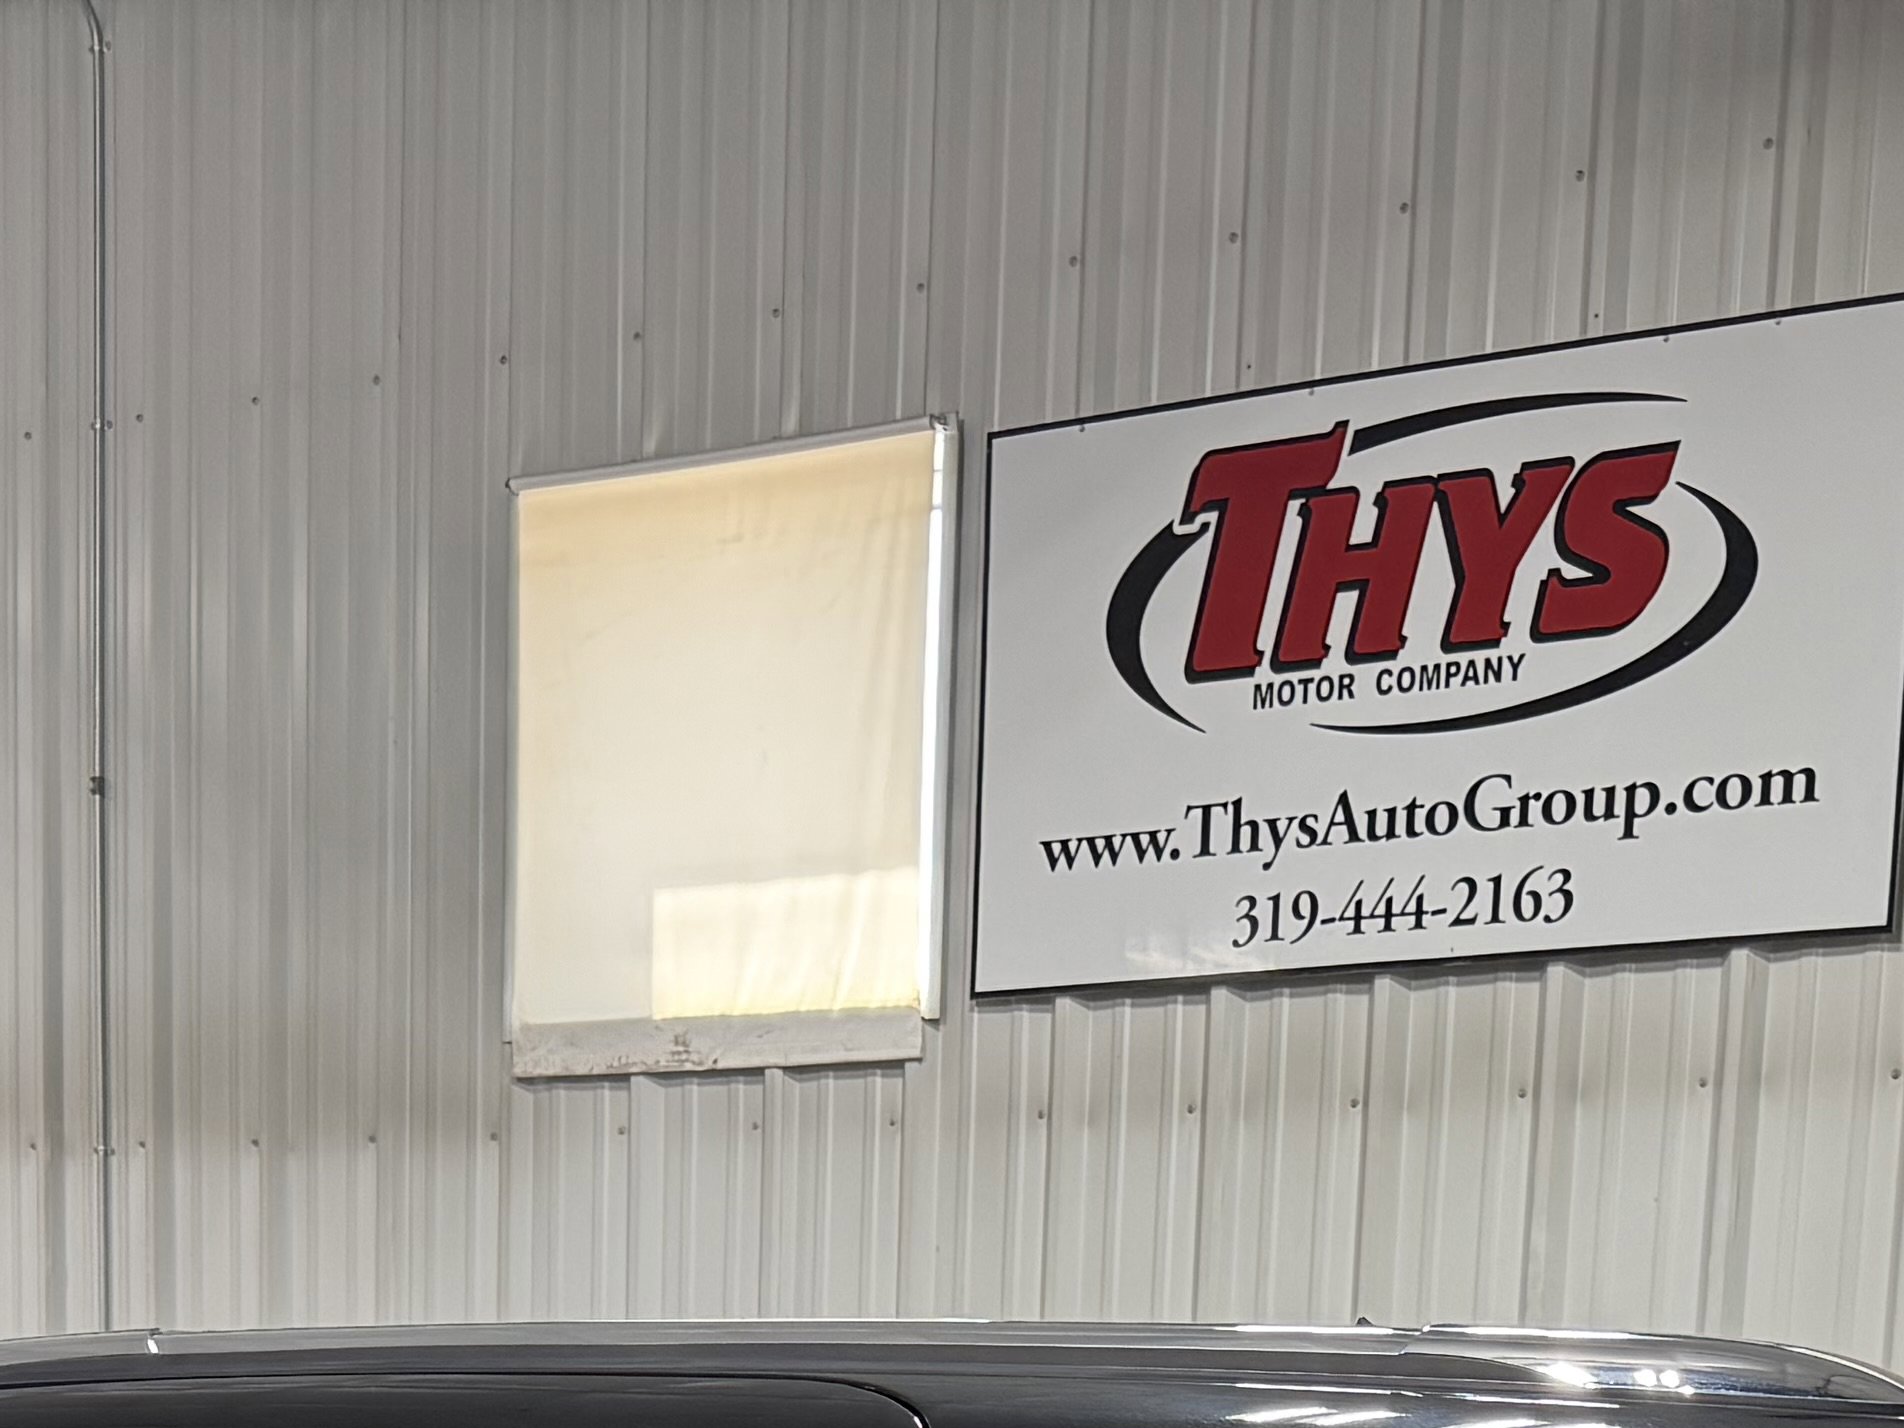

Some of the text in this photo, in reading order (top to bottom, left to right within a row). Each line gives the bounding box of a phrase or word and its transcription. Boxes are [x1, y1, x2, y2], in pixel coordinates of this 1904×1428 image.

[1251, 652, 1527, 712] MOTOR COMPANY
[1039, 765, 1820, 873] www.ThysAutoGroup.com
[1231, 866, 1575, 948] 319-444-2163
